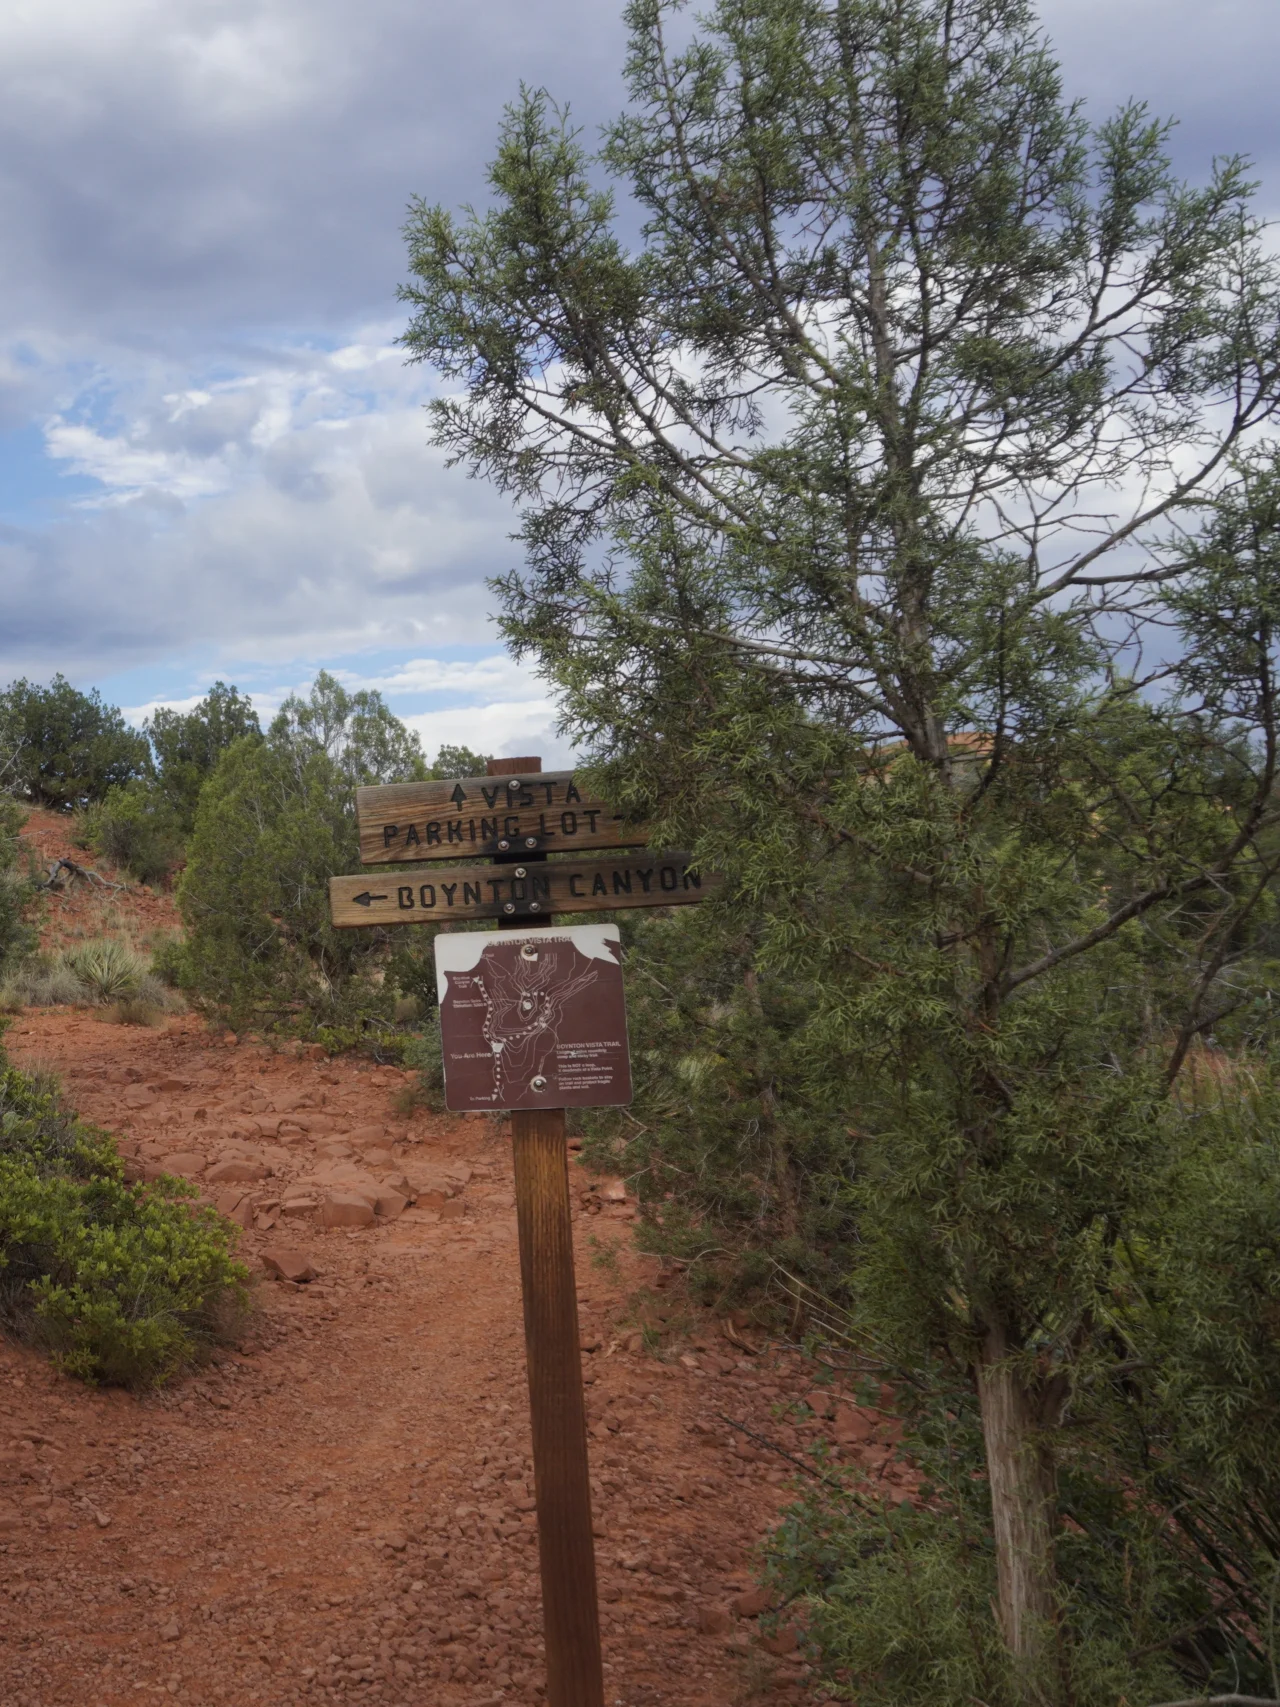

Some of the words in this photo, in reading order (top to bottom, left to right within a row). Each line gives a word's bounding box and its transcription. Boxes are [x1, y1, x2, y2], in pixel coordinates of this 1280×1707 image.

[481, 781, 581, 809] VISTA
[384, 816, 520, 848] PARKING
[540, 809, 601, 837] LOT
[398, 876, 550, 910] BOYNTON
[569, 865, 701, 897] CANYON
[528, 936, 552, 945] VISTA
